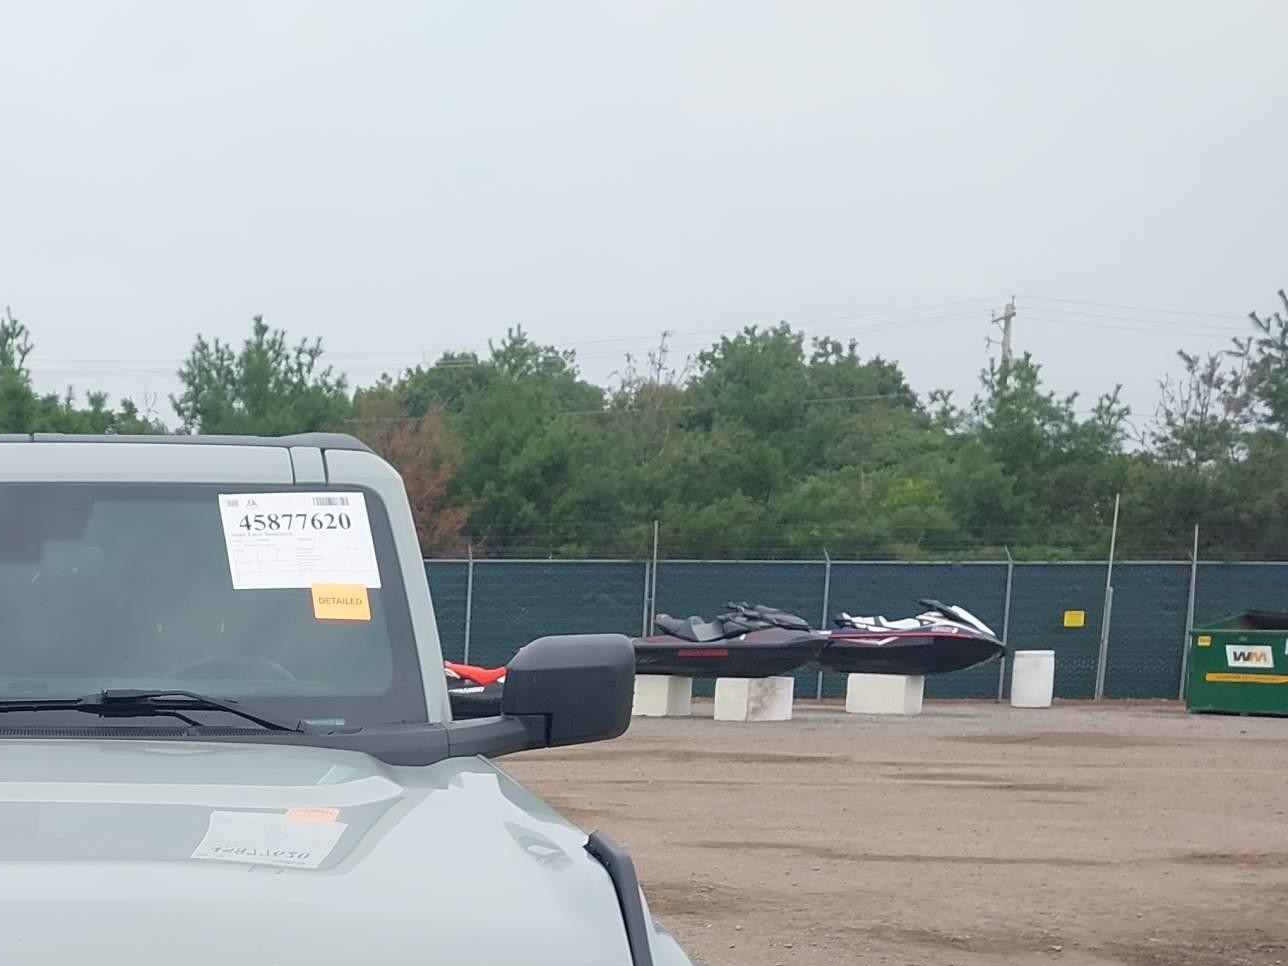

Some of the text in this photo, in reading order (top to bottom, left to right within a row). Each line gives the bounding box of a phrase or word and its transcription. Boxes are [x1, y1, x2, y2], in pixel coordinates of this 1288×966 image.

[239, 512, 352, 531] 45877620
[318, 597, 363, 606] DETAILED
[1233, 651, 1268, 662] WM
